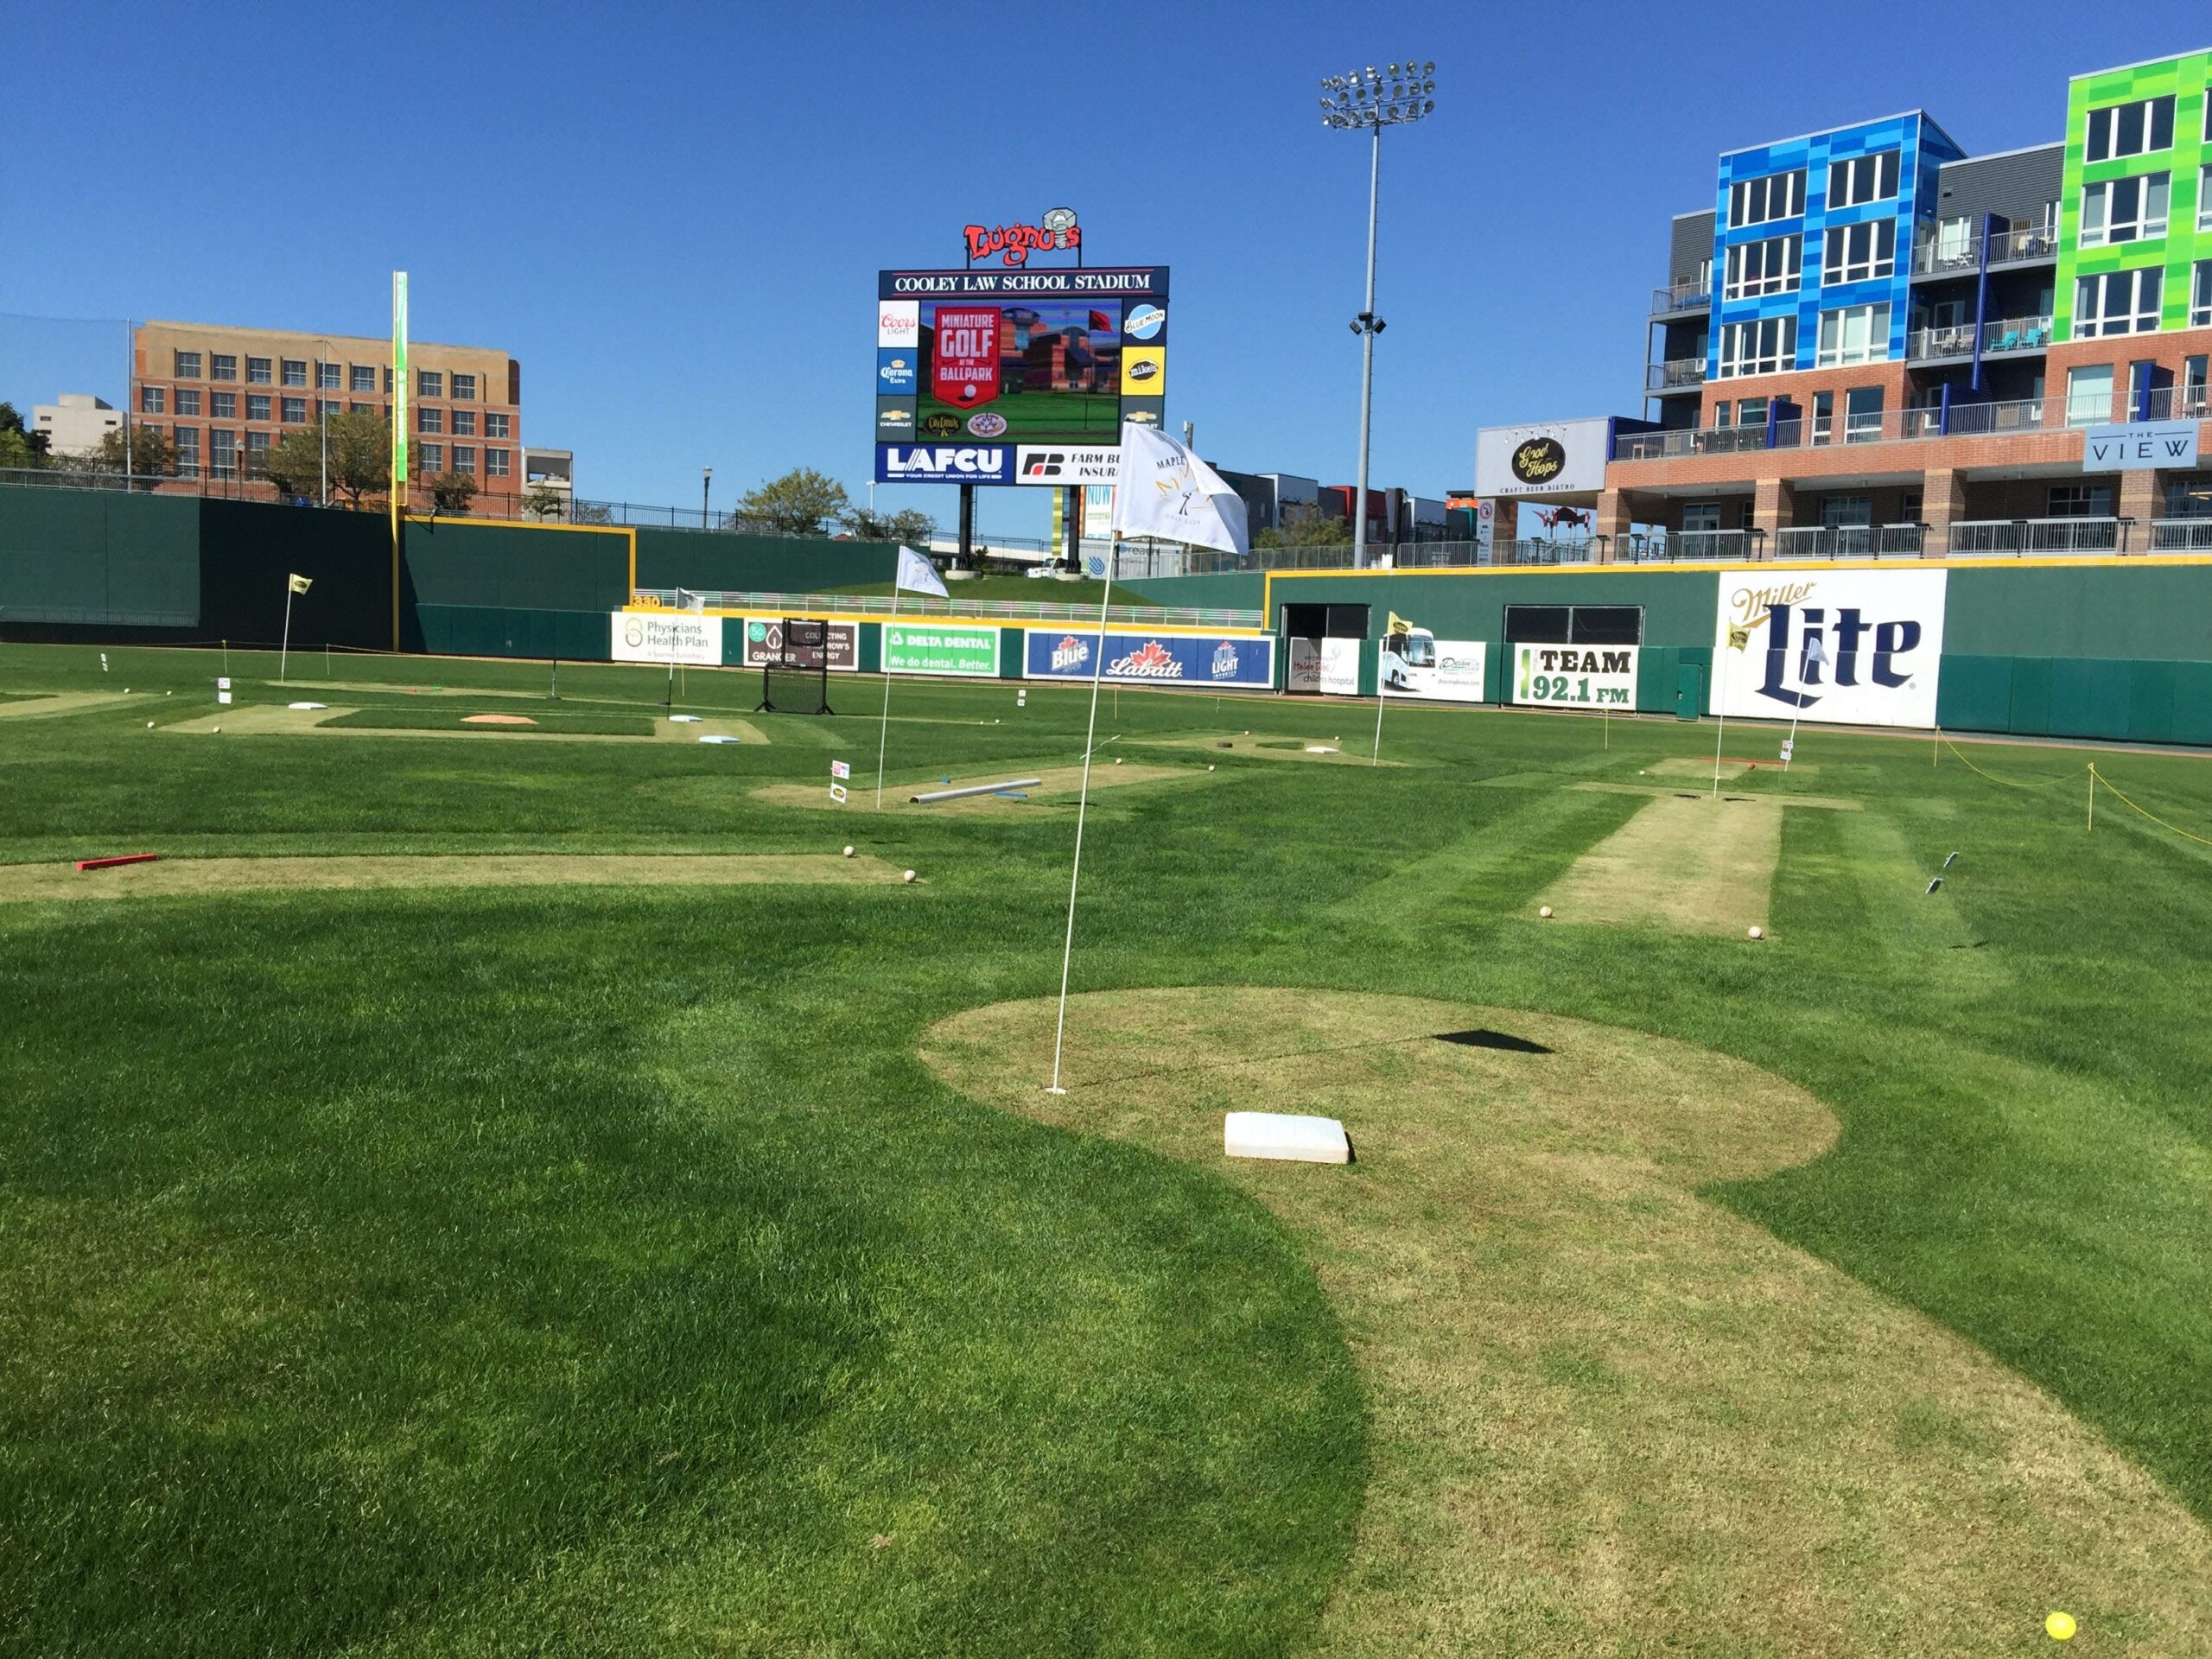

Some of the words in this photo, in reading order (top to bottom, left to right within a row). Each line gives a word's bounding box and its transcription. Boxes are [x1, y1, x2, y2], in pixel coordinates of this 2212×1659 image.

[895, 276, 959, 292] COOLEY
[963, 276, 998, 291] LAW
[1002, 275, 1070, 290] SCHOOL
[1075, 274, 1151, 289] STADIUM
[881, 314, 916, 328] Coors
[941, 315, 995, 328] MINIATURE
[1145, 312, 1164, 323] MOON
[940, 329, 994, 358] GOLF
[880, 366, 913, 379] Corona
[940, 367, 993, 381] BALLPARK
[1071, 453, 1103, 463] FARM
[2093, 440, 2189, 461] VIEW
[887, 448, 1002, 473] LAFCU
[1156, 455, 1185, 470] MAPLE
[1526, 459, 1558, 478] Hops
[1548, 483, 1575, 492] BISTRO
[633, 596, 660, 607] 330
[1732, 581, 1818, 623] Miller
[647, 621, 702, 635] Physicians
[647, 635, 683, 646] Health
[685, 636, 709, 647] Plan
[906, 634, 943, 648] DELTA
[944, 636, 991, 650] DENTAL
[890, 655, 906, 666] We
[907, 657, 920, 667] do
[922, 657, 957, 669] dental.
[958, 658, 991, 671] Better.
[1051, 646, 1089, 671] Blue
[1540, 650, 1631, 674] TEAM
[1754, 603, 1921, 709] Lite
[1106, 658, 1182, 678] Labatt
[1212, 658, 1239, 674] LIGHT
[1328, 676, 1355, 686] hospital
[1532, 675, 1591, 702] 92.1
[1596, 688, 1630, 703] FM
